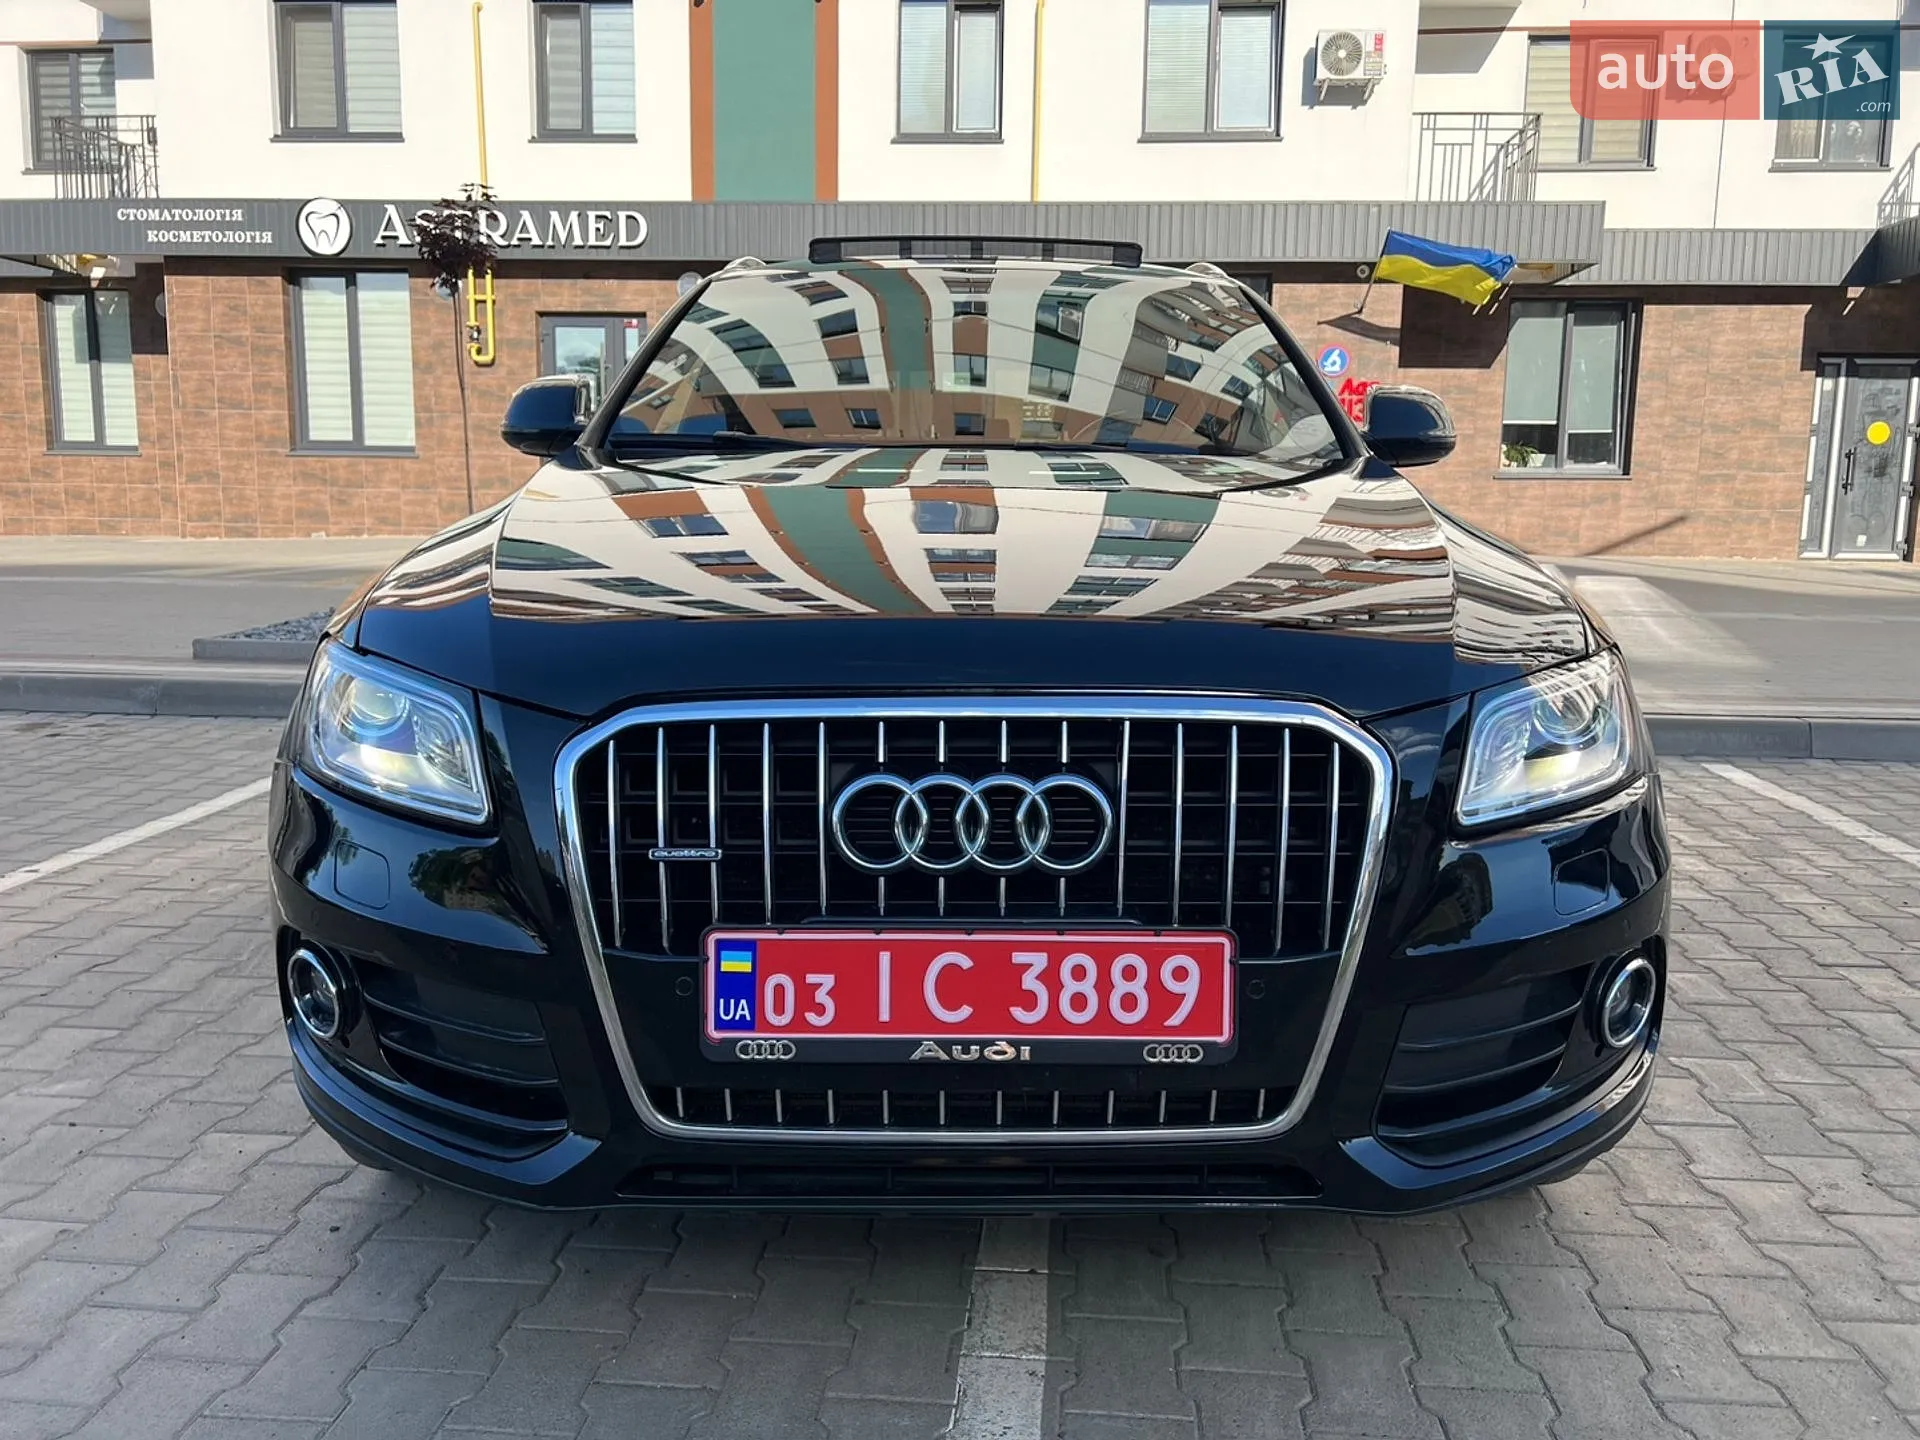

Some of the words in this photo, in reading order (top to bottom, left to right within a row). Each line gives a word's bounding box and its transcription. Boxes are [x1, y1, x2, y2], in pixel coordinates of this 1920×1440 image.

[116, 208, 244, 222] СТОМАТОЛОГІЯ
[147, 230, 273, 244] КОСМЕТОЛОГІЯ
[763, 973, 836, 1028] 03
[1009, 951, 1201, 1027] 3889
[719, 998, 751, 1021] UA
